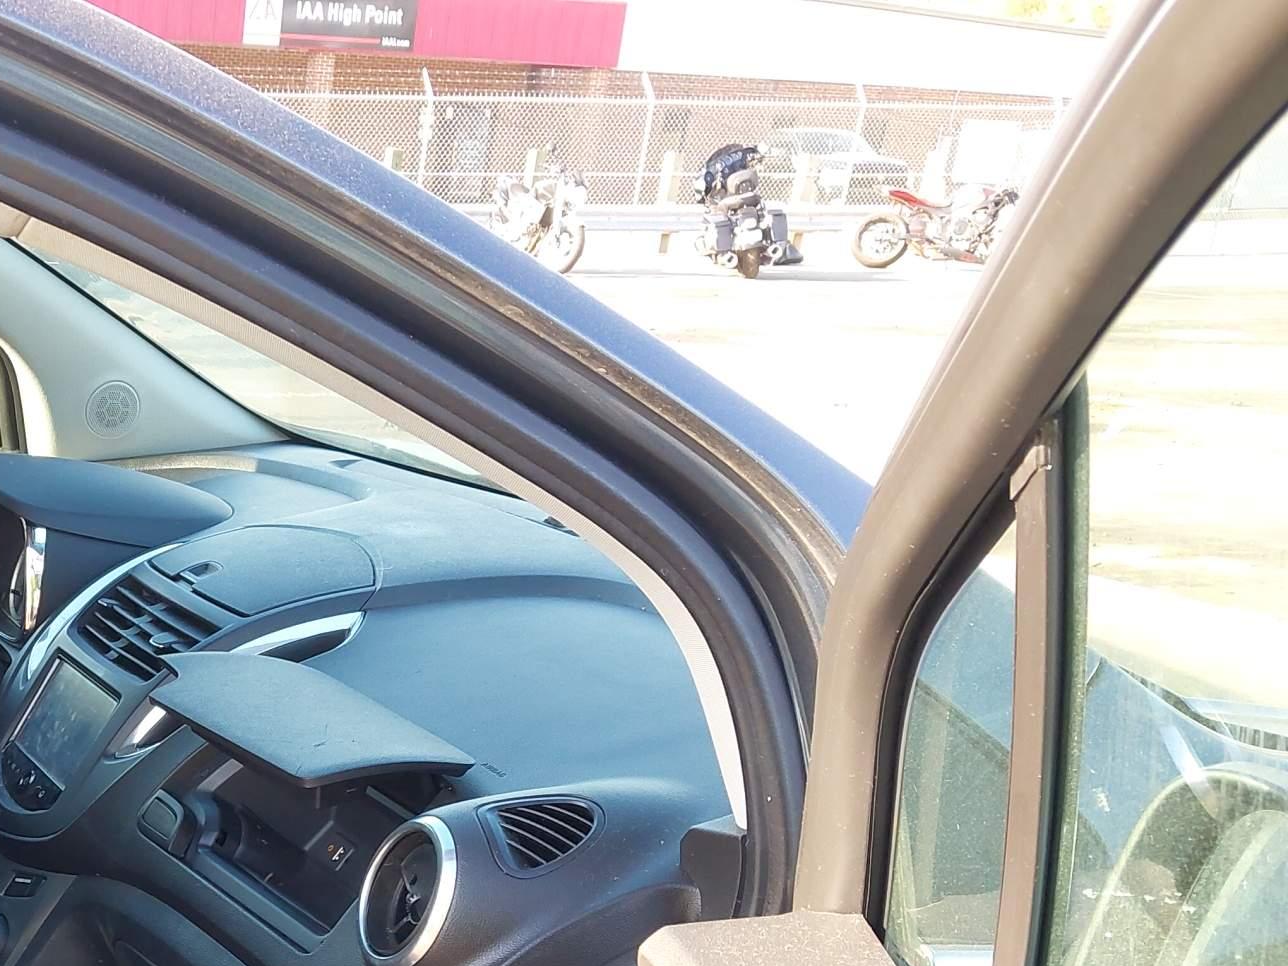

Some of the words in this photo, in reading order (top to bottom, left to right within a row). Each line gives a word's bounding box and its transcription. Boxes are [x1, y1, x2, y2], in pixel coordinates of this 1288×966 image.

[296, 0, 324, 21] IAA
[327, 2, 361, 26] High
[364, 4, 403, 25] Point
